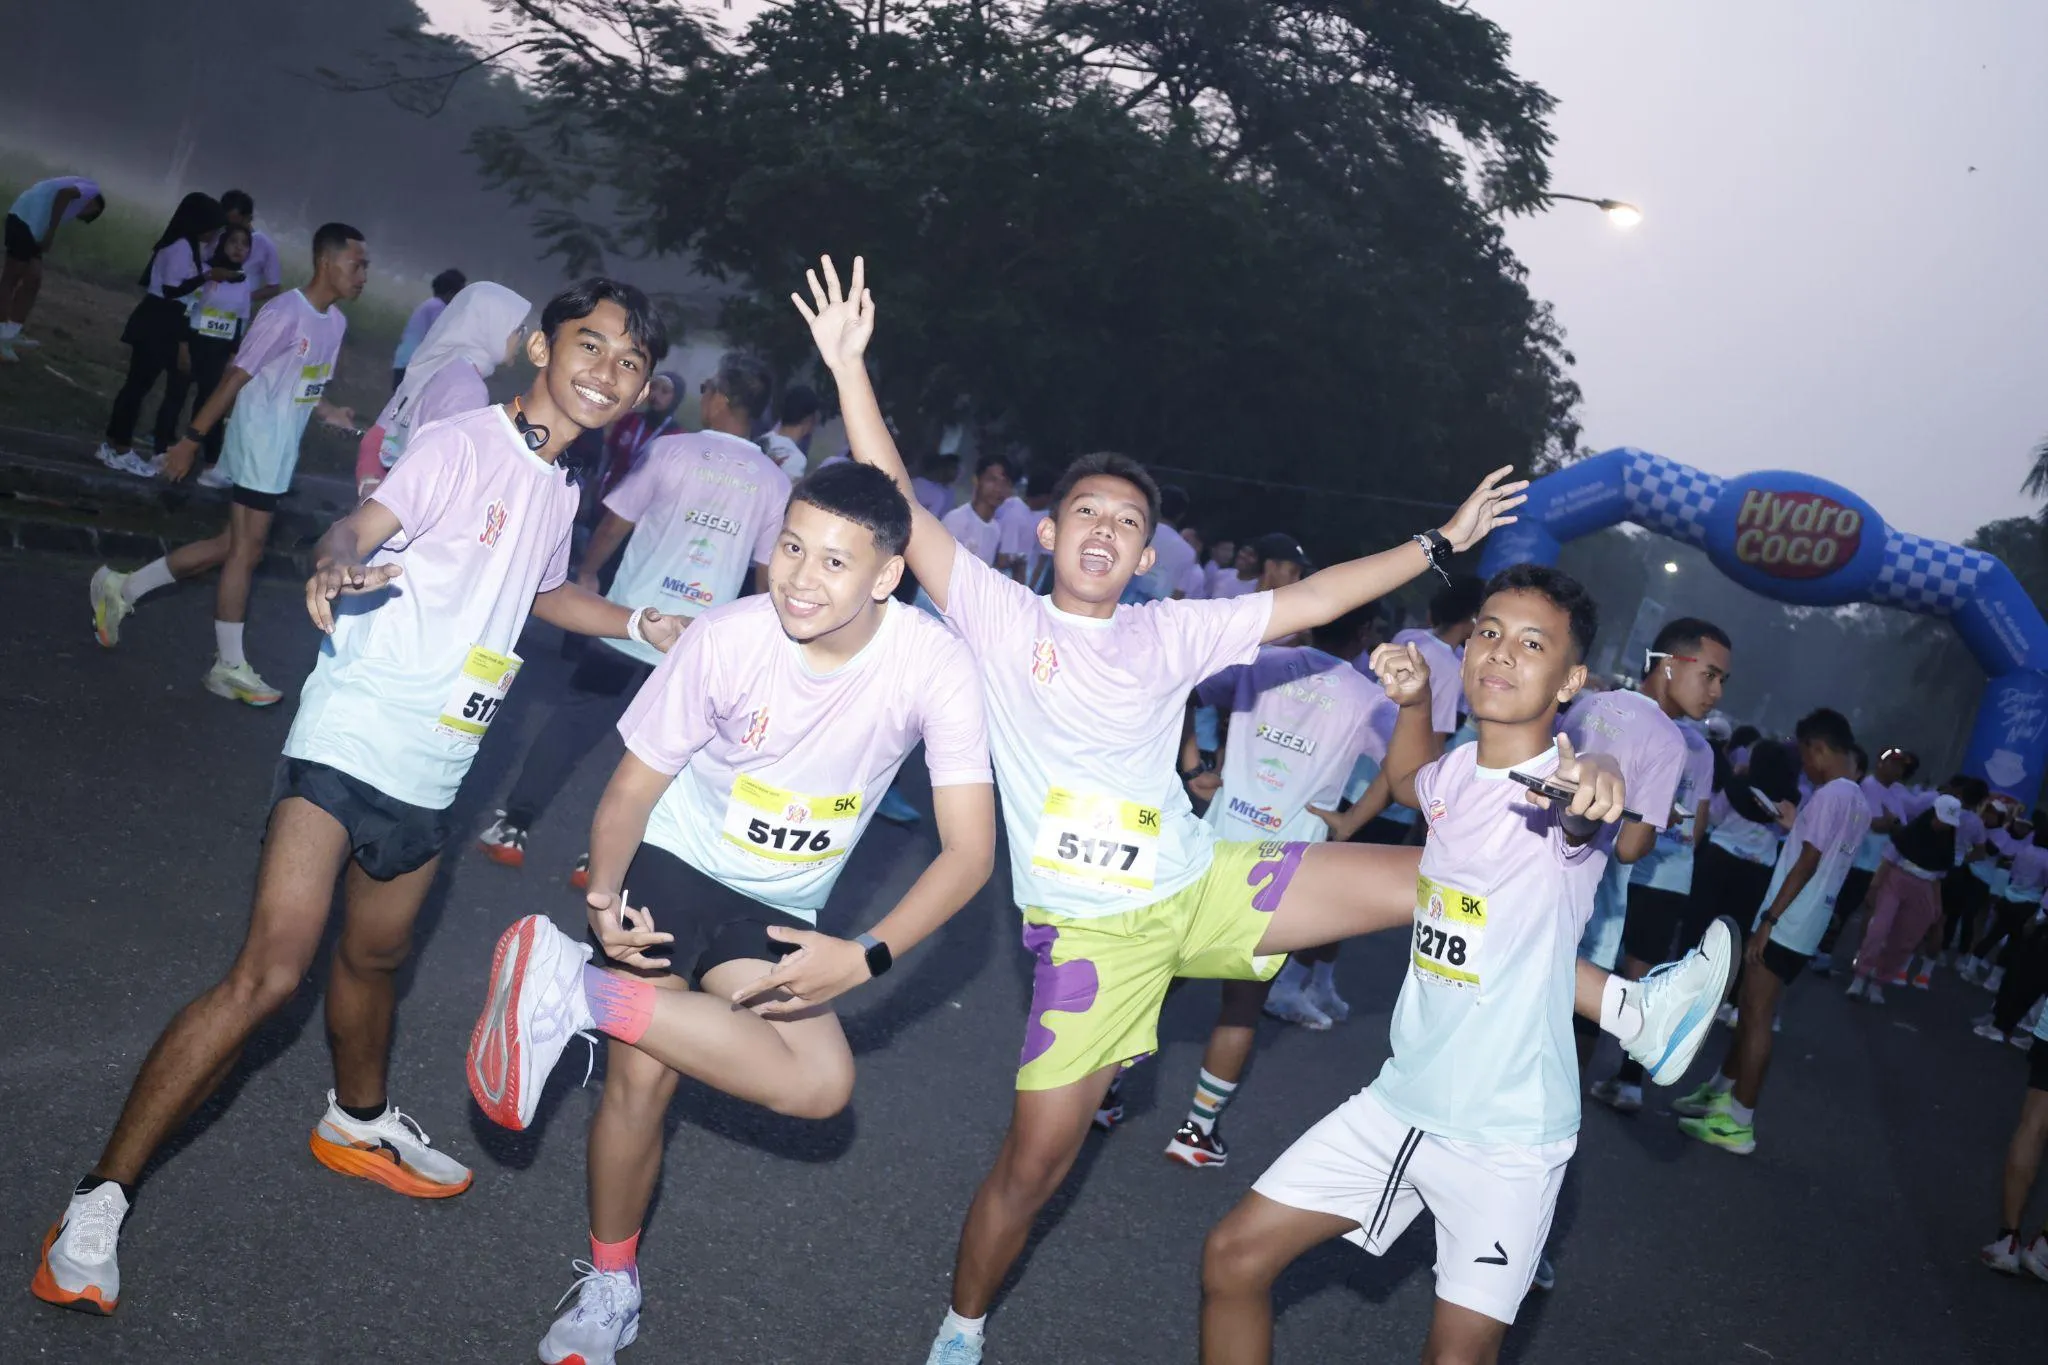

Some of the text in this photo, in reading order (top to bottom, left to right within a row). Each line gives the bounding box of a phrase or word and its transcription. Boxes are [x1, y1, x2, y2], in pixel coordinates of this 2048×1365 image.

[485, 500, 507, 531] RUN
[685, 509, 741, 537] REGEN
[1737, 490, 1859, 536] Hydro
[479, 522, 502, 548] JOY
[462, 691, 504, 724] 517
[1256, 723, 1317, 756] REGEN
[834, 796, 857, 812] 5K
[1138, 809, 1157, 827] 5K
[747, 818, 831, 852] 5176
[1057, 831, 1140, 871] 5177
[1461, 896, 1482, 916] 5K
[1415, 924, 1467, 966] 5278
